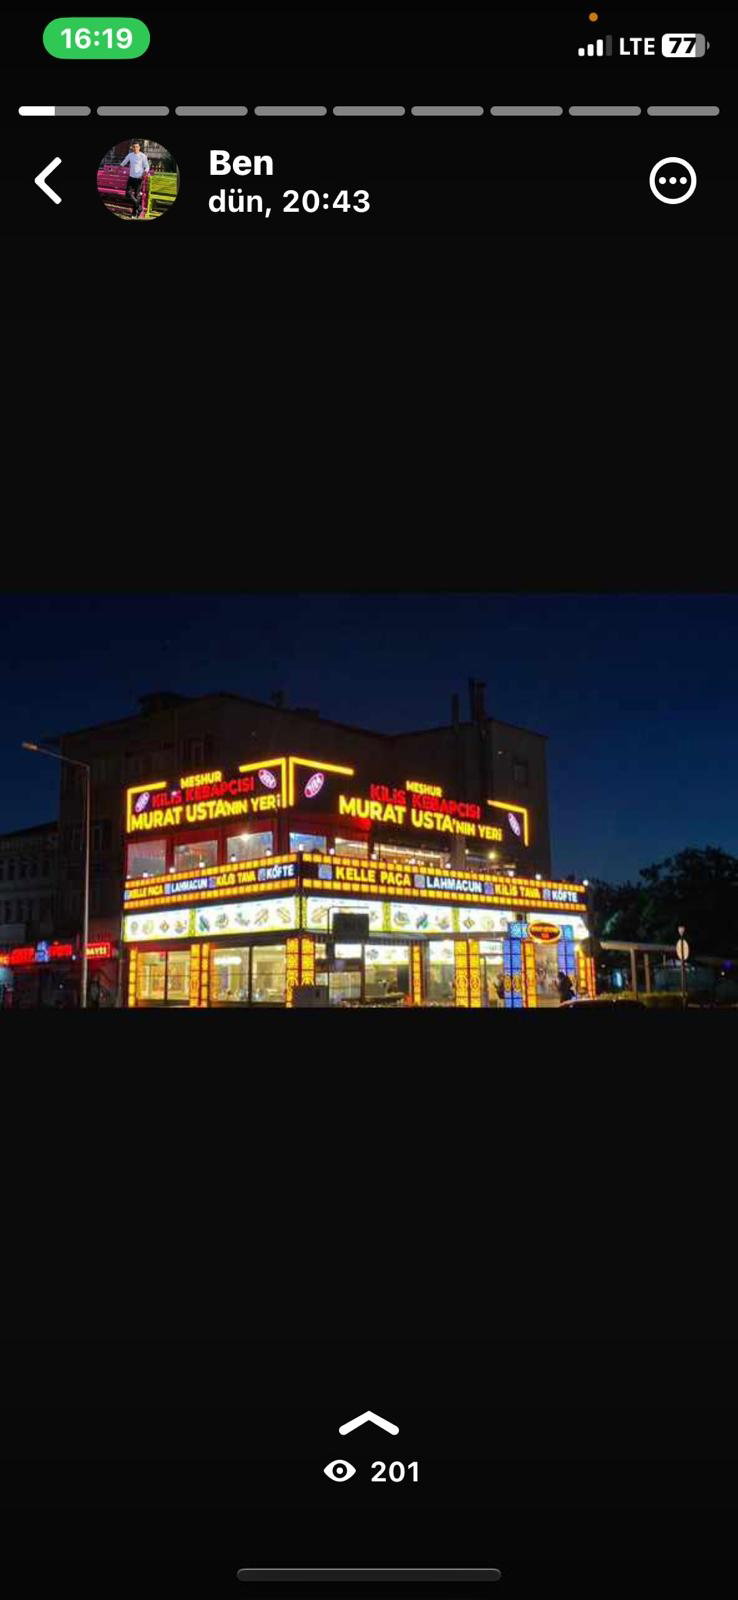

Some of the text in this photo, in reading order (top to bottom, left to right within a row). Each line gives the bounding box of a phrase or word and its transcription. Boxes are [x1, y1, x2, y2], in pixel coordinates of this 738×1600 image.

[131, 806, 183, 831] MURAT
[338, 794, 406, 824] MURAT
[411, 808, 476, 836] USTA'NIN
[266, 864, 294, 881] KÖFTE
[335, 866, 376, 883] KELLE
[426, 875, 483, 894] LAHMACUN
